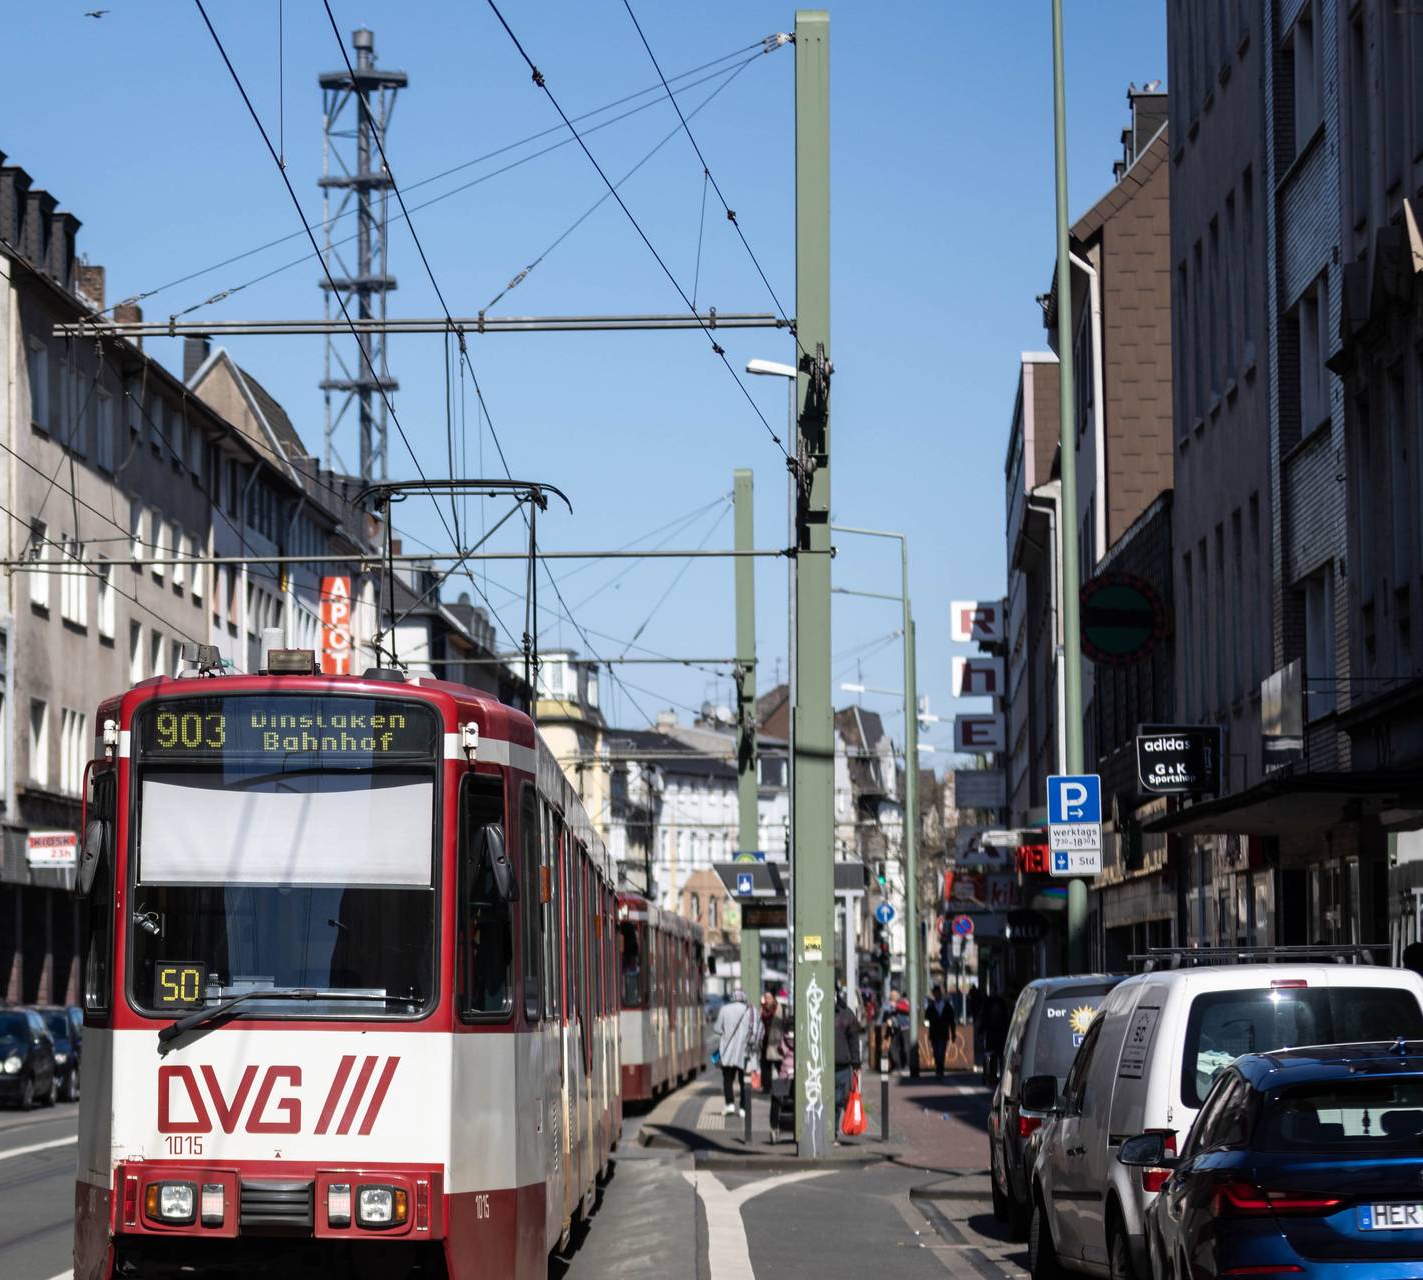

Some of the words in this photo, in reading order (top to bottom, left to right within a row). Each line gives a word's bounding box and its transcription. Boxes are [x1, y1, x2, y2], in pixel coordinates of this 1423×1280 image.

[157, 712, 226, 748] 903
[250, 711, 406, 729] Dinslaken
[263, 731, 393, 751] Bahnhof
[1144, 737, 1191, 752] adidas
[1155, 763, 1165, 775] G
[1176, 763, 1187, 775] K
[1060, 782, 1088, 821] P
[34, 836, 70, 847] KIOSK
[1053, 828, 1097, 839] werktags
[161, 968, 200, 1002] 50
[1047, 1008, 1067, 1018] Der
[157, 1065, 302, 1134] DVG
[165, 1136, 203, 1155] 1015
[475, 1194, 490, 1219] 1015
[1374, 1205, 1419, 1225] HER
